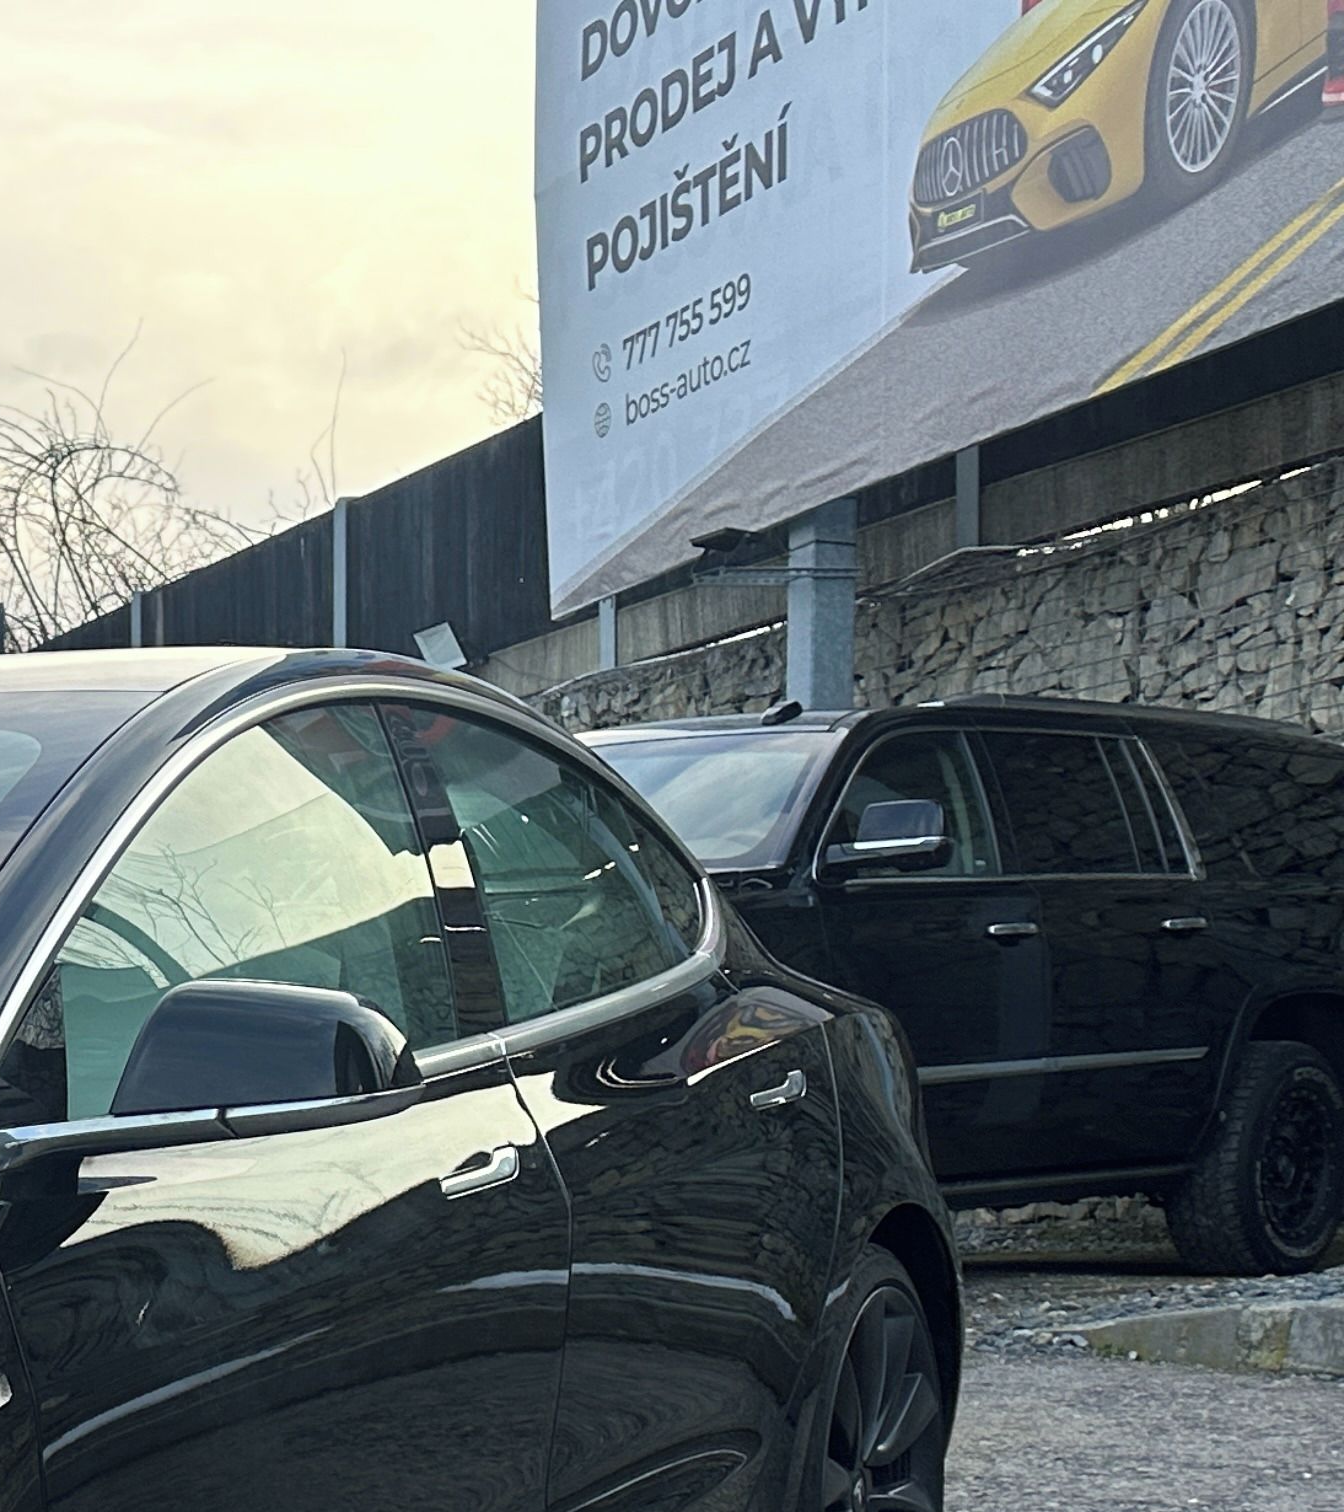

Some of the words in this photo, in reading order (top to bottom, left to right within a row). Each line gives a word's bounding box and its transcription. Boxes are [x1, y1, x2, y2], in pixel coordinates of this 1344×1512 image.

[579, 31, 737, 184] PRODEJ
[747, 9, 783, 80] A
[585, 100, 793, 291] POJIŠTĚNÍ
[622, 320, 661, 371] 777
[665, 297, 704, 348] 755
[708, 273, 751, 325] 599
[624, 339, 751, 426] boss-auto.cz
